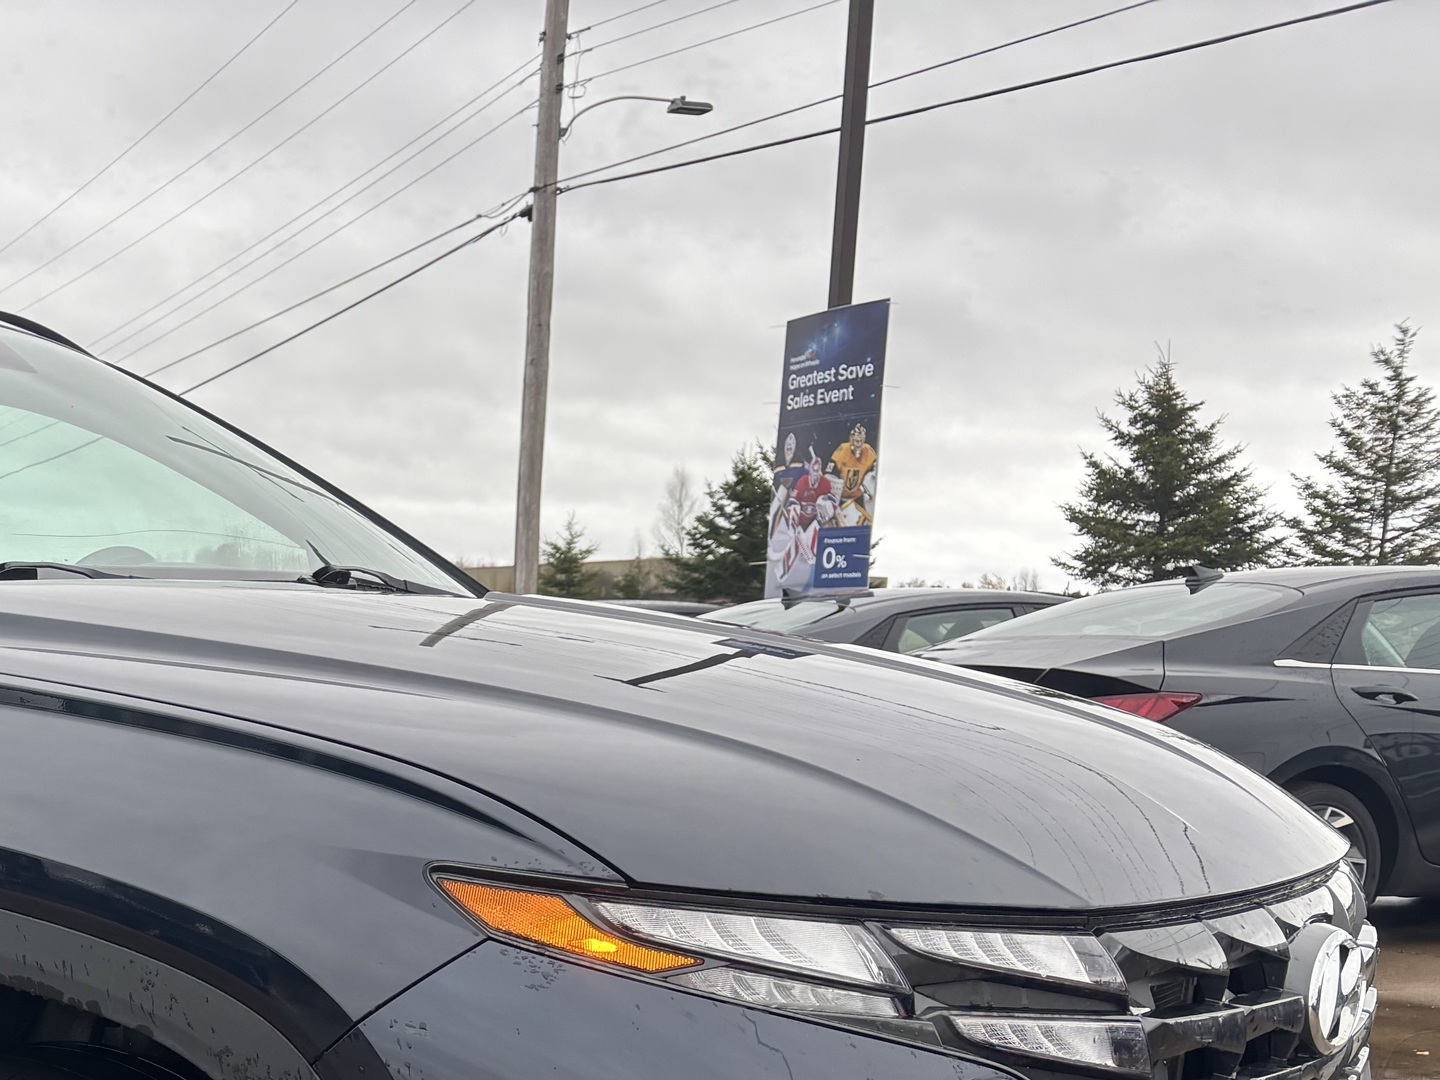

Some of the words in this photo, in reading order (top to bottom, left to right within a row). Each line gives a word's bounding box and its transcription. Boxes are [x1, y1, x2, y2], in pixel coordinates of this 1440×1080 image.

[788, 367, 836, 390] Greatest
[838, 363, 874, 381] Save
[786, 392, 815, 411] Sales
[816, 385, 854, 405] Event
[822, 546, 847, 569] 0%
